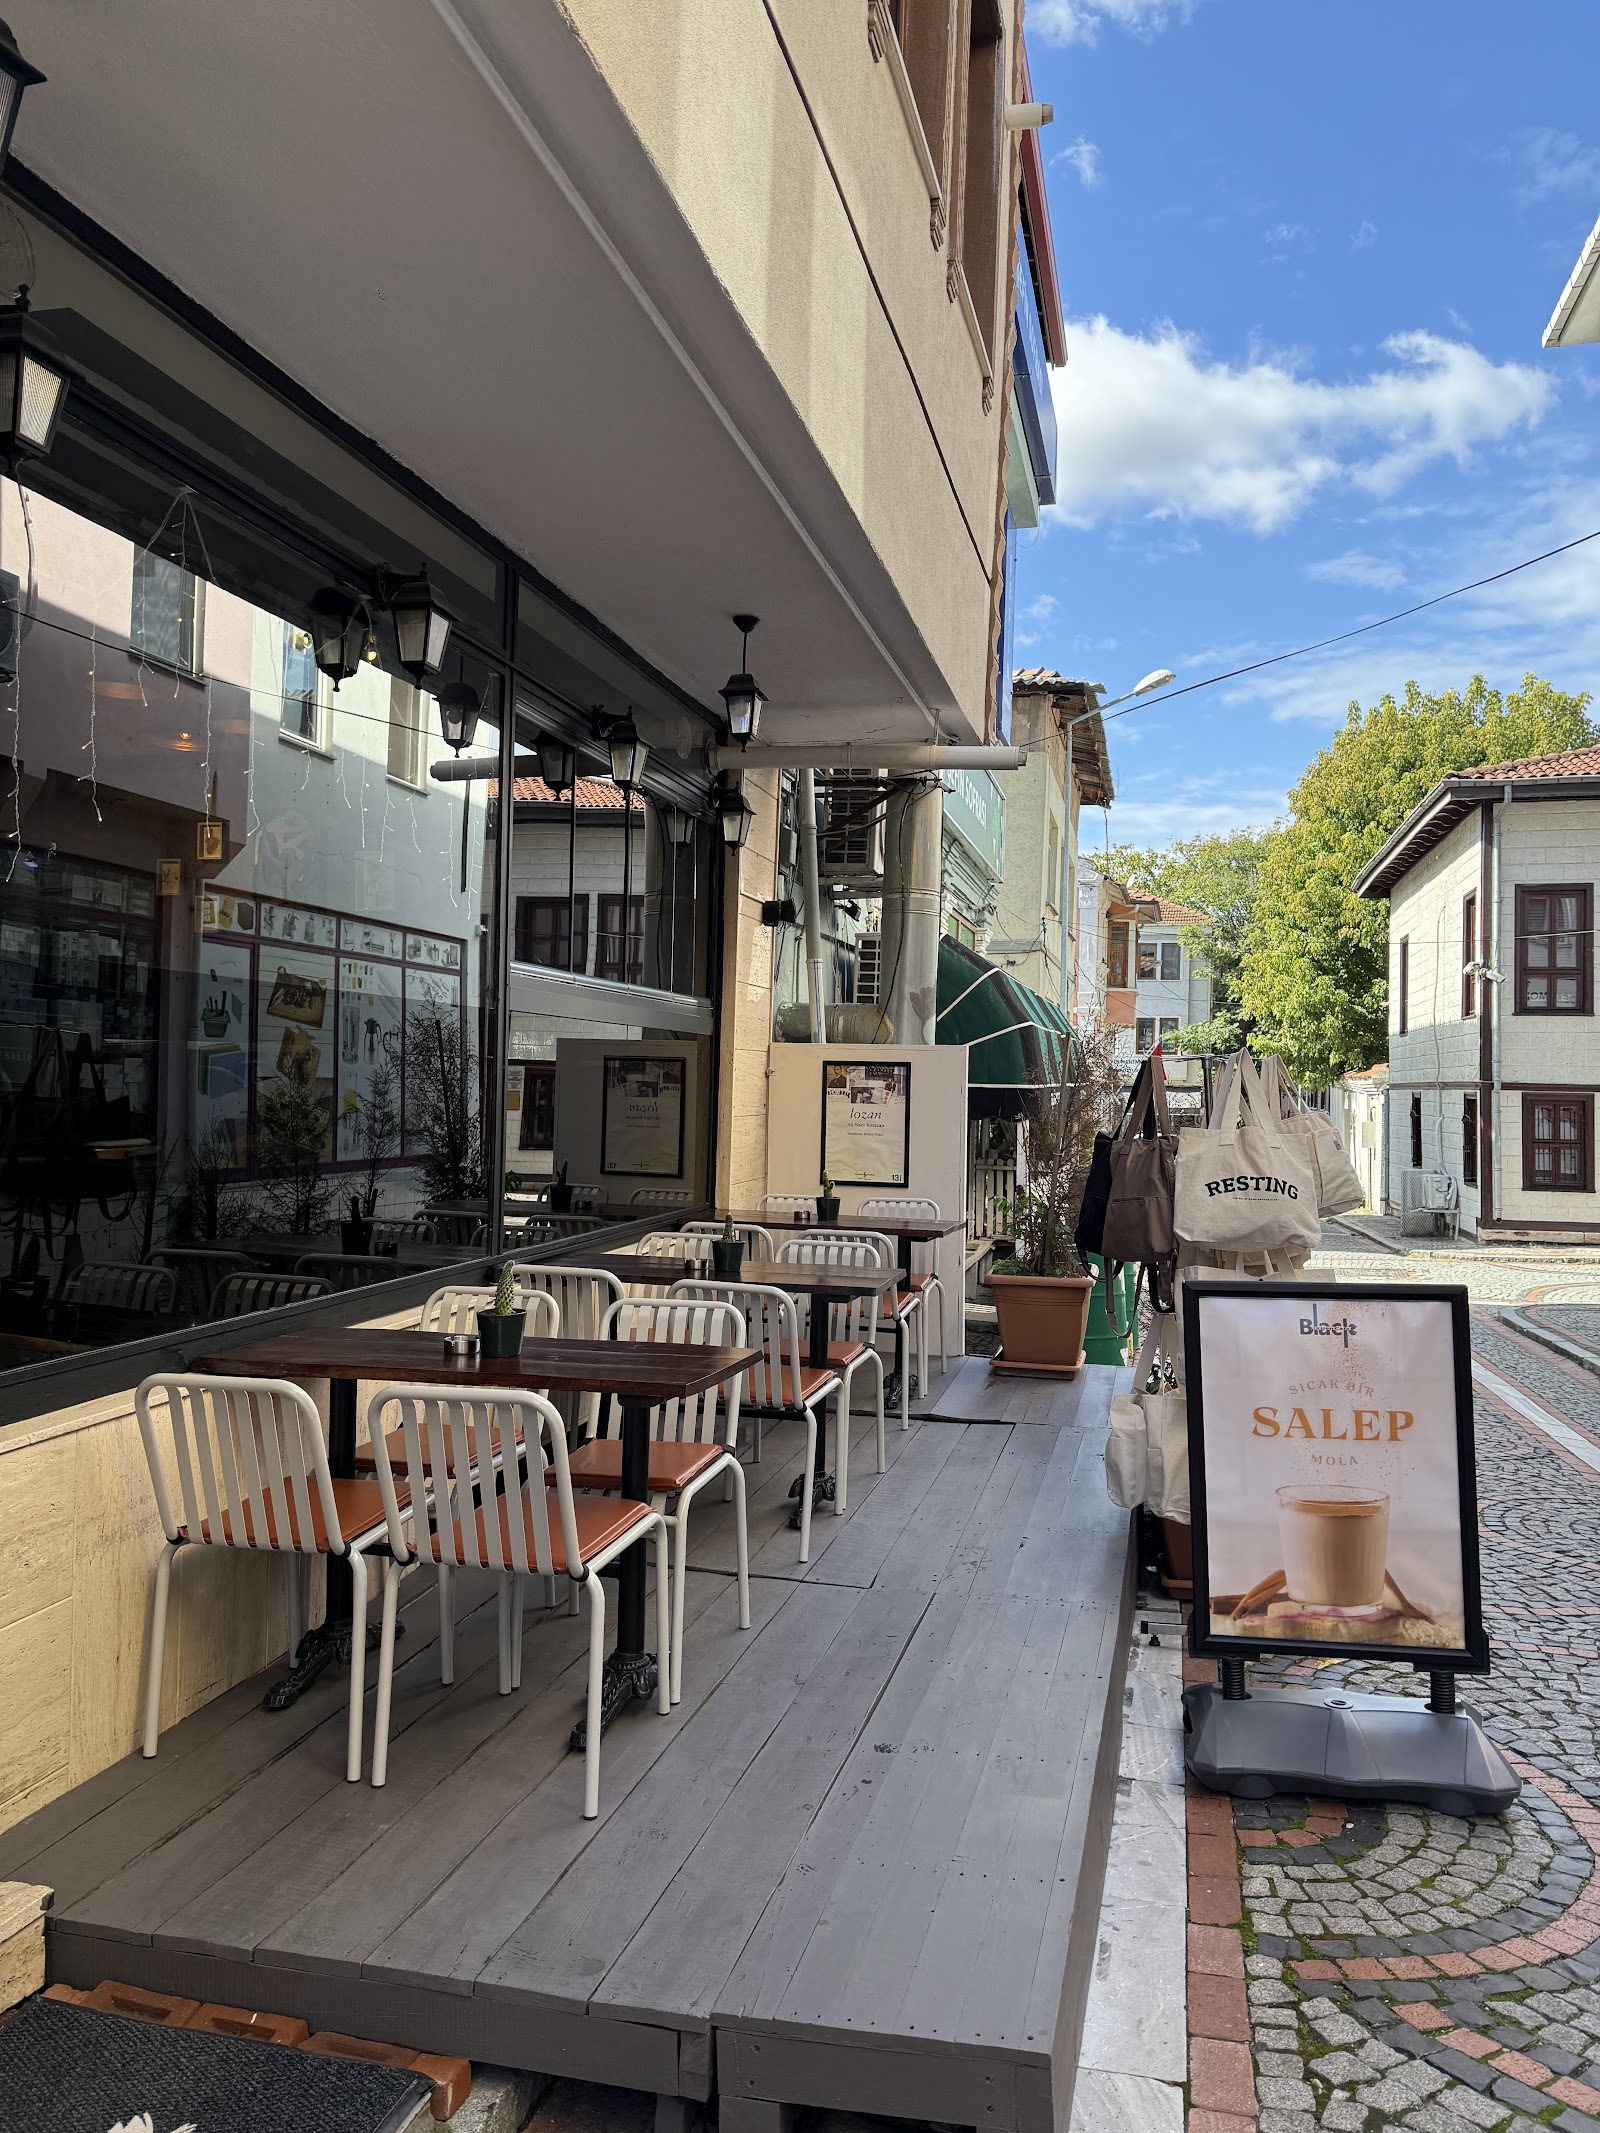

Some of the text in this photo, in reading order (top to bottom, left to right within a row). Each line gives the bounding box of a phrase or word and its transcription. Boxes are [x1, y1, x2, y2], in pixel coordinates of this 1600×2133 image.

[965, 775, 987, 829] SOFRASI
[849, 1107, 882, 1120] lozan
[1205, 1175, 1299, 1200] RESTING
[1300, 1303, 1357, 1349] Black
[1289, 1379, 1339, 1395] SICAK
[1252, 1406, 1414, 1442] SALEP
[1310, 1453, 1359, 1467] MOLA
